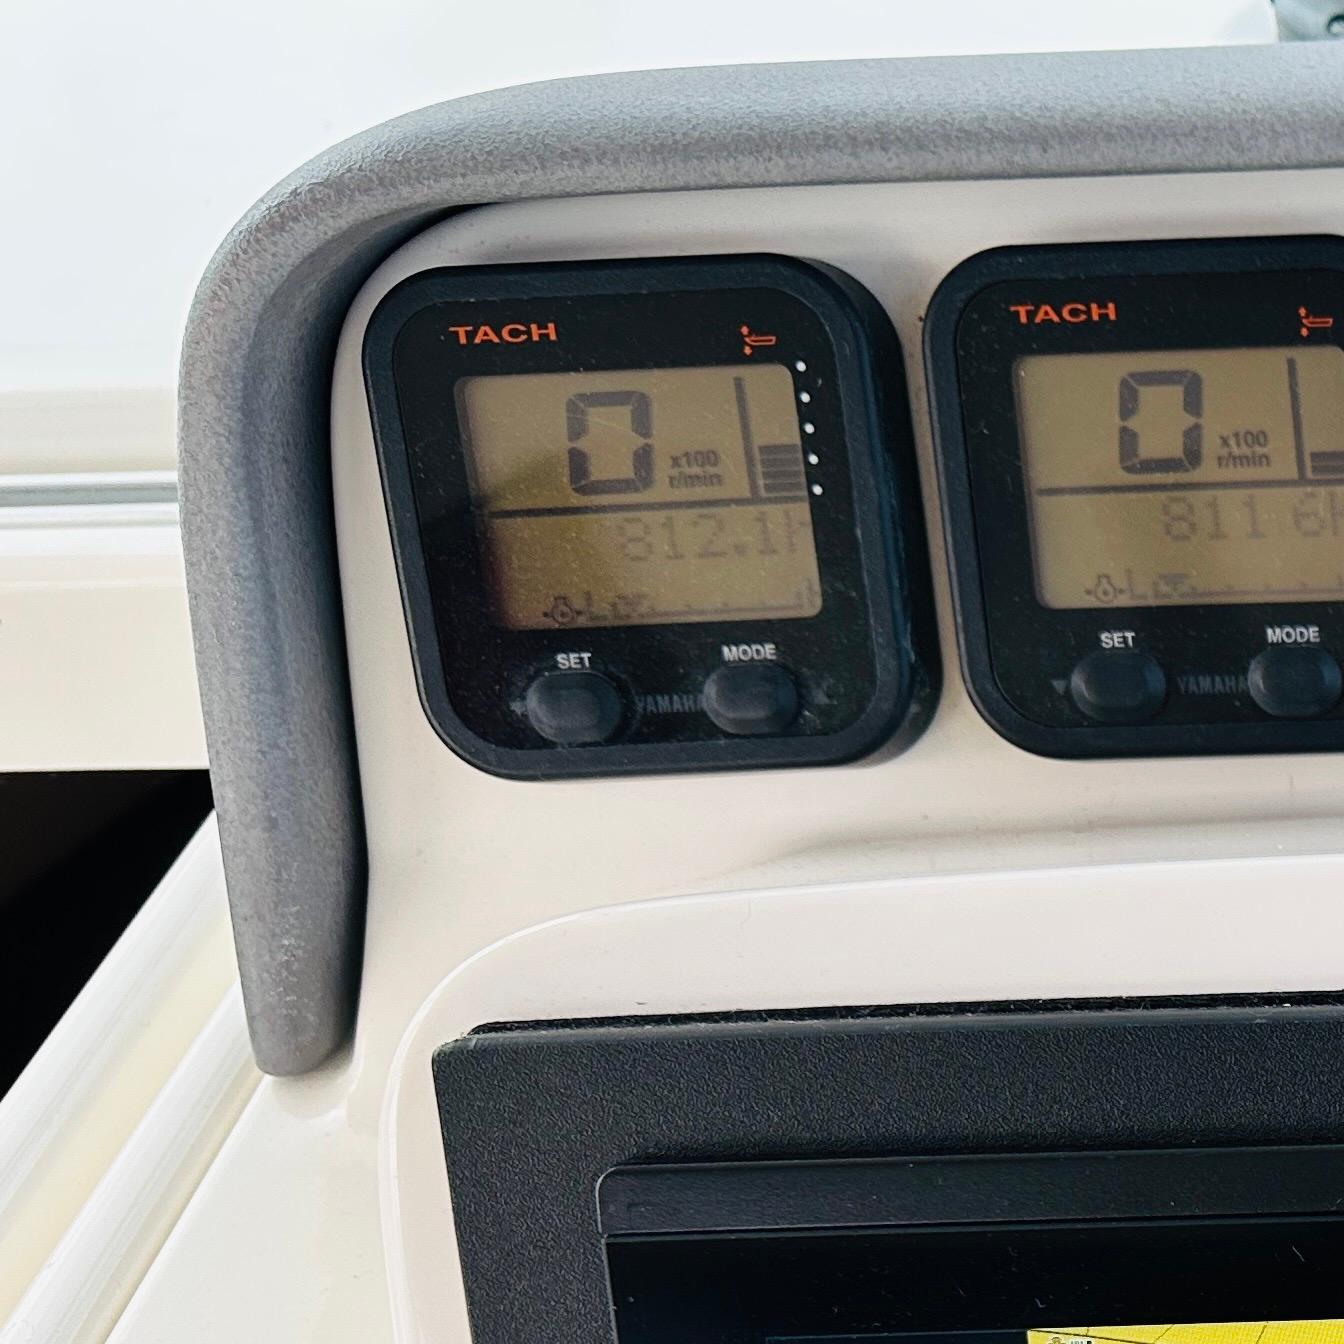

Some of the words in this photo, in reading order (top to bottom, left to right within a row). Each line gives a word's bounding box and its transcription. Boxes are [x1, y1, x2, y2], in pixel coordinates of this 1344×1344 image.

[1009, 303, 1117, 325] TACH
[449, 323, 558, 345] TACH
[1118, 369, 1204, 475] 0
[565, 390, 655, 497] 0
[1219, 431, 1268, 449] x100
[1217, 451, 1271, 470] r/min
[668, 471, 725, 489] r/min
[1100, 631, 1135, 649] SET
[1266, 625, 1321, 644] MODE
[557, 652, 591, 669] SET
[722, 644, 777, 662] MODE
[1177, 675, 1247, 695] YAMAHA
